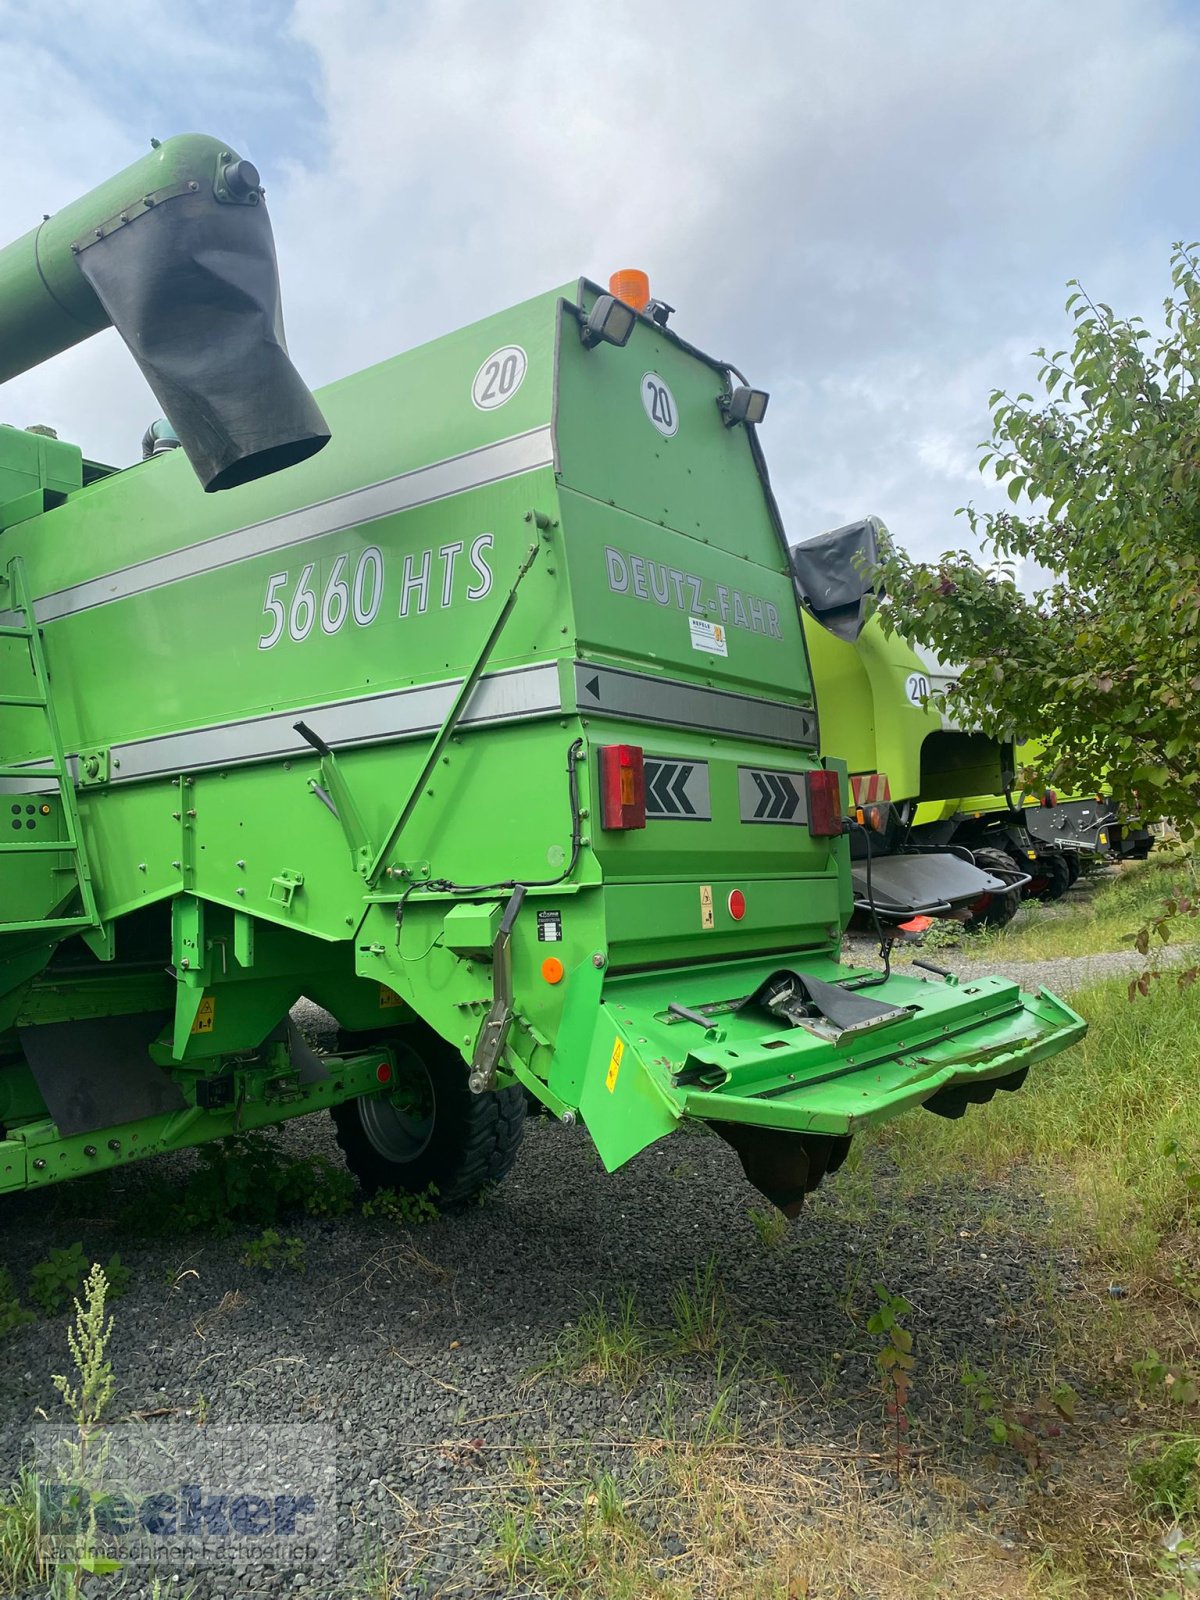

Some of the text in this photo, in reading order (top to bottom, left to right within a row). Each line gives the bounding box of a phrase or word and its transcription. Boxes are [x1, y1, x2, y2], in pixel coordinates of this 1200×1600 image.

[480, 355, 518, 402] 20
[647, 381, 673, 428] 20
[257, 532, 495, 650] 5660 HTS
[605, 545, 784, 641] DEUTZ-FAHR
[909, 677, 927, 701] 20
